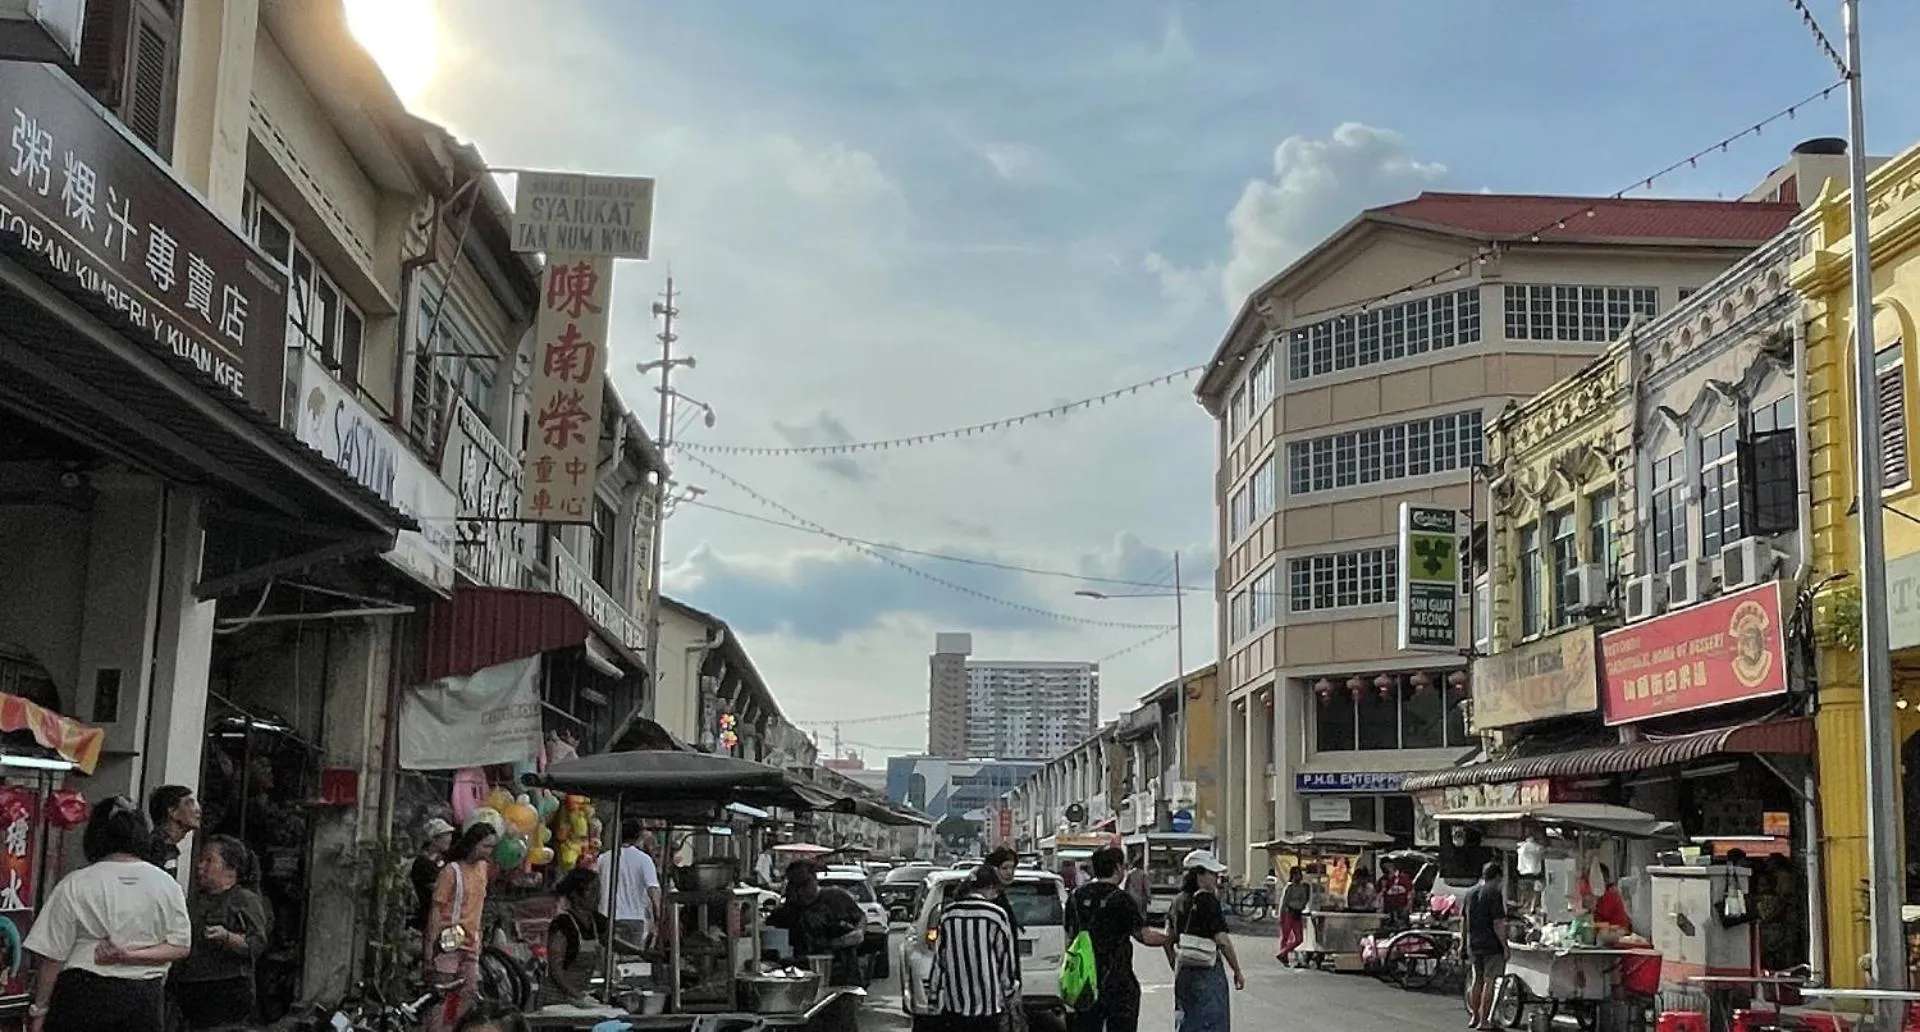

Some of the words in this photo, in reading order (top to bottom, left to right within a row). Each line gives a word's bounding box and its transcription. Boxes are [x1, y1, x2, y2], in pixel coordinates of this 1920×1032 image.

[531, 197, 634, 226] SYARIKAT
[519, 223, 549, 249] TAN
[556, 224, 593, 251] NUM
[601, 227, 647, 253] WING
[538, 261, 602, 451] 陳南榮
[1411, 597, 1427, 611] SIN
[1414, 611, 1450, 627] KEONG
